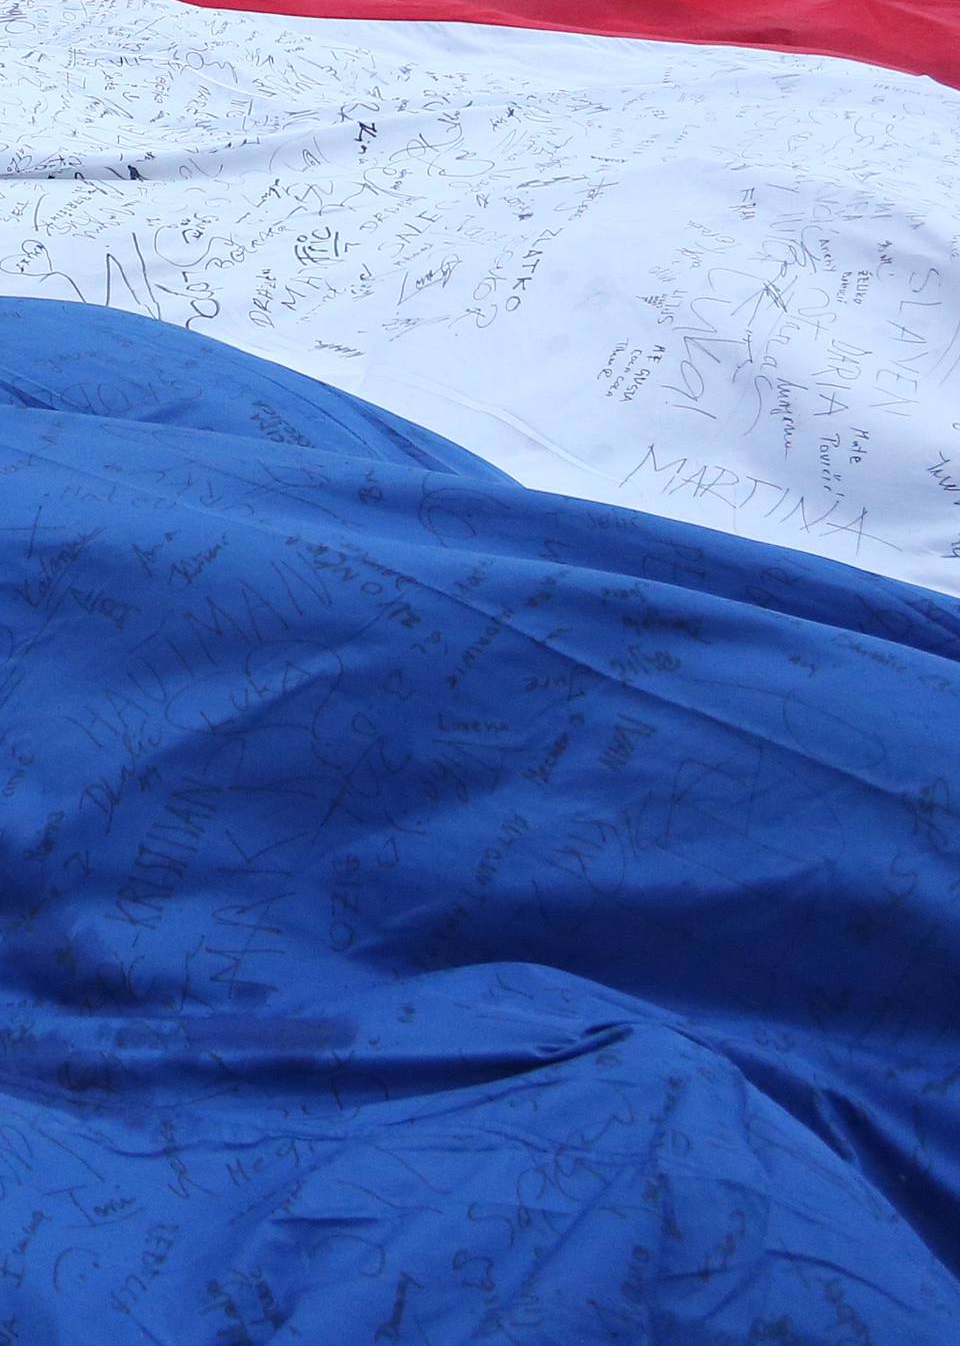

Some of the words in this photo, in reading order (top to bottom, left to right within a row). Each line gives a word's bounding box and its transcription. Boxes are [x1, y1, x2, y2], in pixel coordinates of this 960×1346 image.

[505, 226, 564, 312] ZLATKO
[811, 339, 874, 417] DARIA
[868, 267, 943, 418] SLAVEN
[849, 426, 870, 466] Mate
[618, 443, 903, 556] MARTINA
